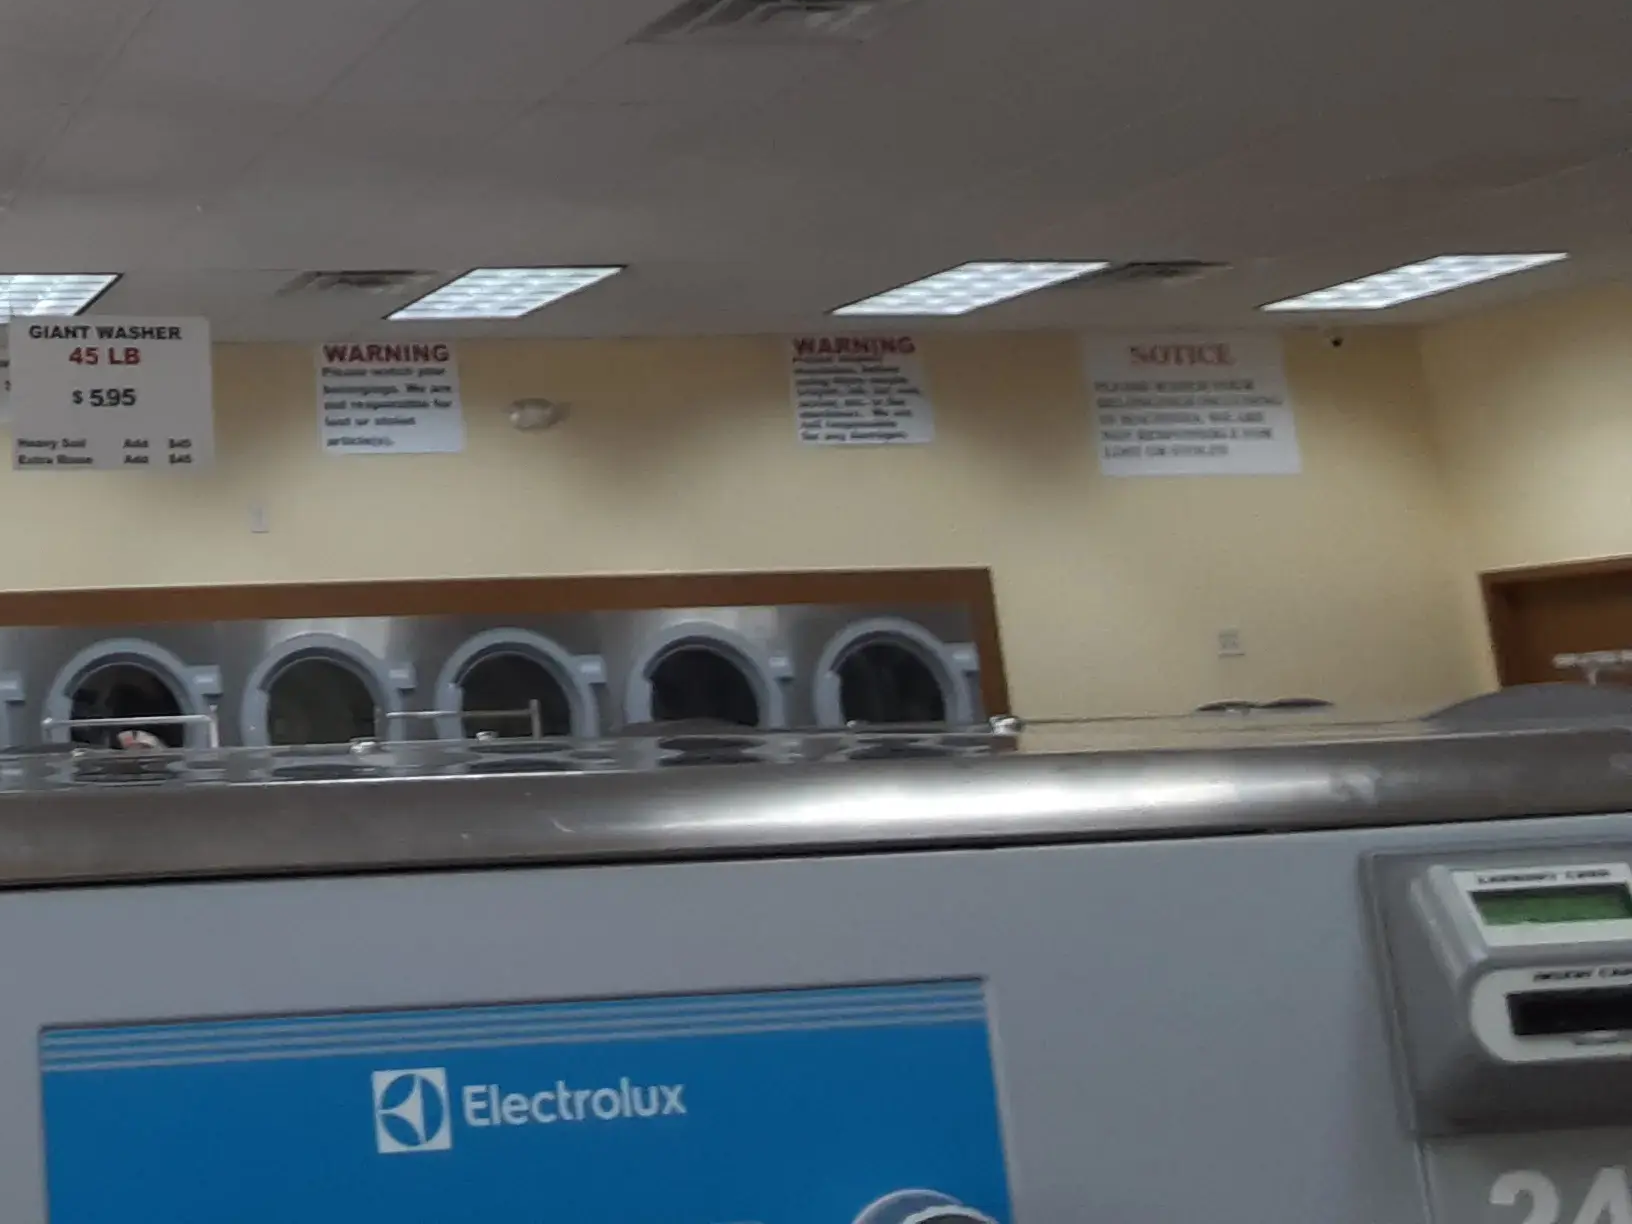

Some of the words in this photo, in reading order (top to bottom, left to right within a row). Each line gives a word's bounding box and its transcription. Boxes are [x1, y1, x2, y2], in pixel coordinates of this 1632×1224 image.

[29, 325, 89, 339] GIANT
[97, 326, 182, 340] WASHER
[323, 344, 449, 362] WARNING
[792, 337, 916, 354] WARNING
[69, 347, 98, 365] 45
[108, 347, 141, 365] LB
[462, 1077, 687, 1127] Electrolux
